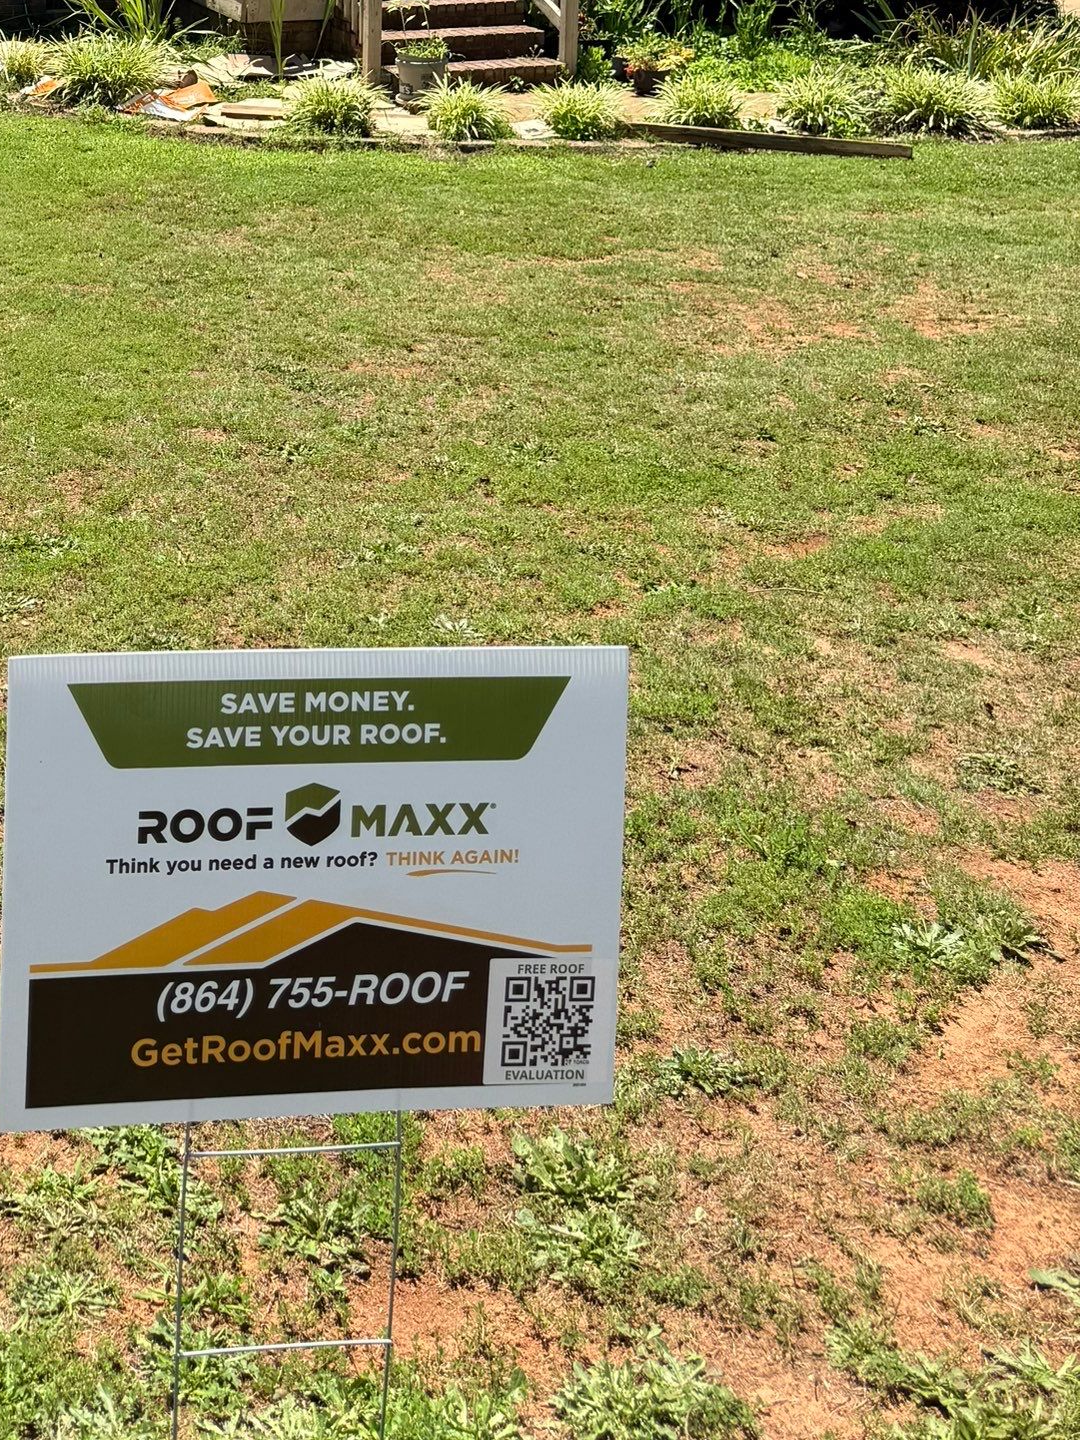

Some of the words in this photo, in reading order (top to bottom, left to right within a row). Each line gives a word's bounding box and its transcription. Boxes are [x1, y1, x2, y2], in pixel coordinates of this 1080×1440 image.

[220, 692, 295, 714] SAVE
[305, 691, 415, 713] MONEY.
[186, 726, 261, 748] SAVE
[271, 725, 351, 747] YOUR
[360, 723, 446, 745] ROOF.
[137, 807, 273, 844] ROOF
[106, 858, 160, 874] Think
[166, 860, 202, 875] you
[208, 854, 257, 871] need
[263, 856, 274, 869] a
[280, 856, 320, 869] new
[326, 851, 378, 868] roof?
[386, 850, 445, 866] THINK
[450, 849, 520, 864] AGAIN!
[517, 964, 546, 974] FREE
[550, 964, 585, 974] ROOF
[156, 978, 254, 1022] (864)
[267, 971, 470, 1009] 755-ROOF
[131, 1029, 482, 1067] GetRoofMaxx.com
[505, 1069, 585, 1080] EVALUATION
